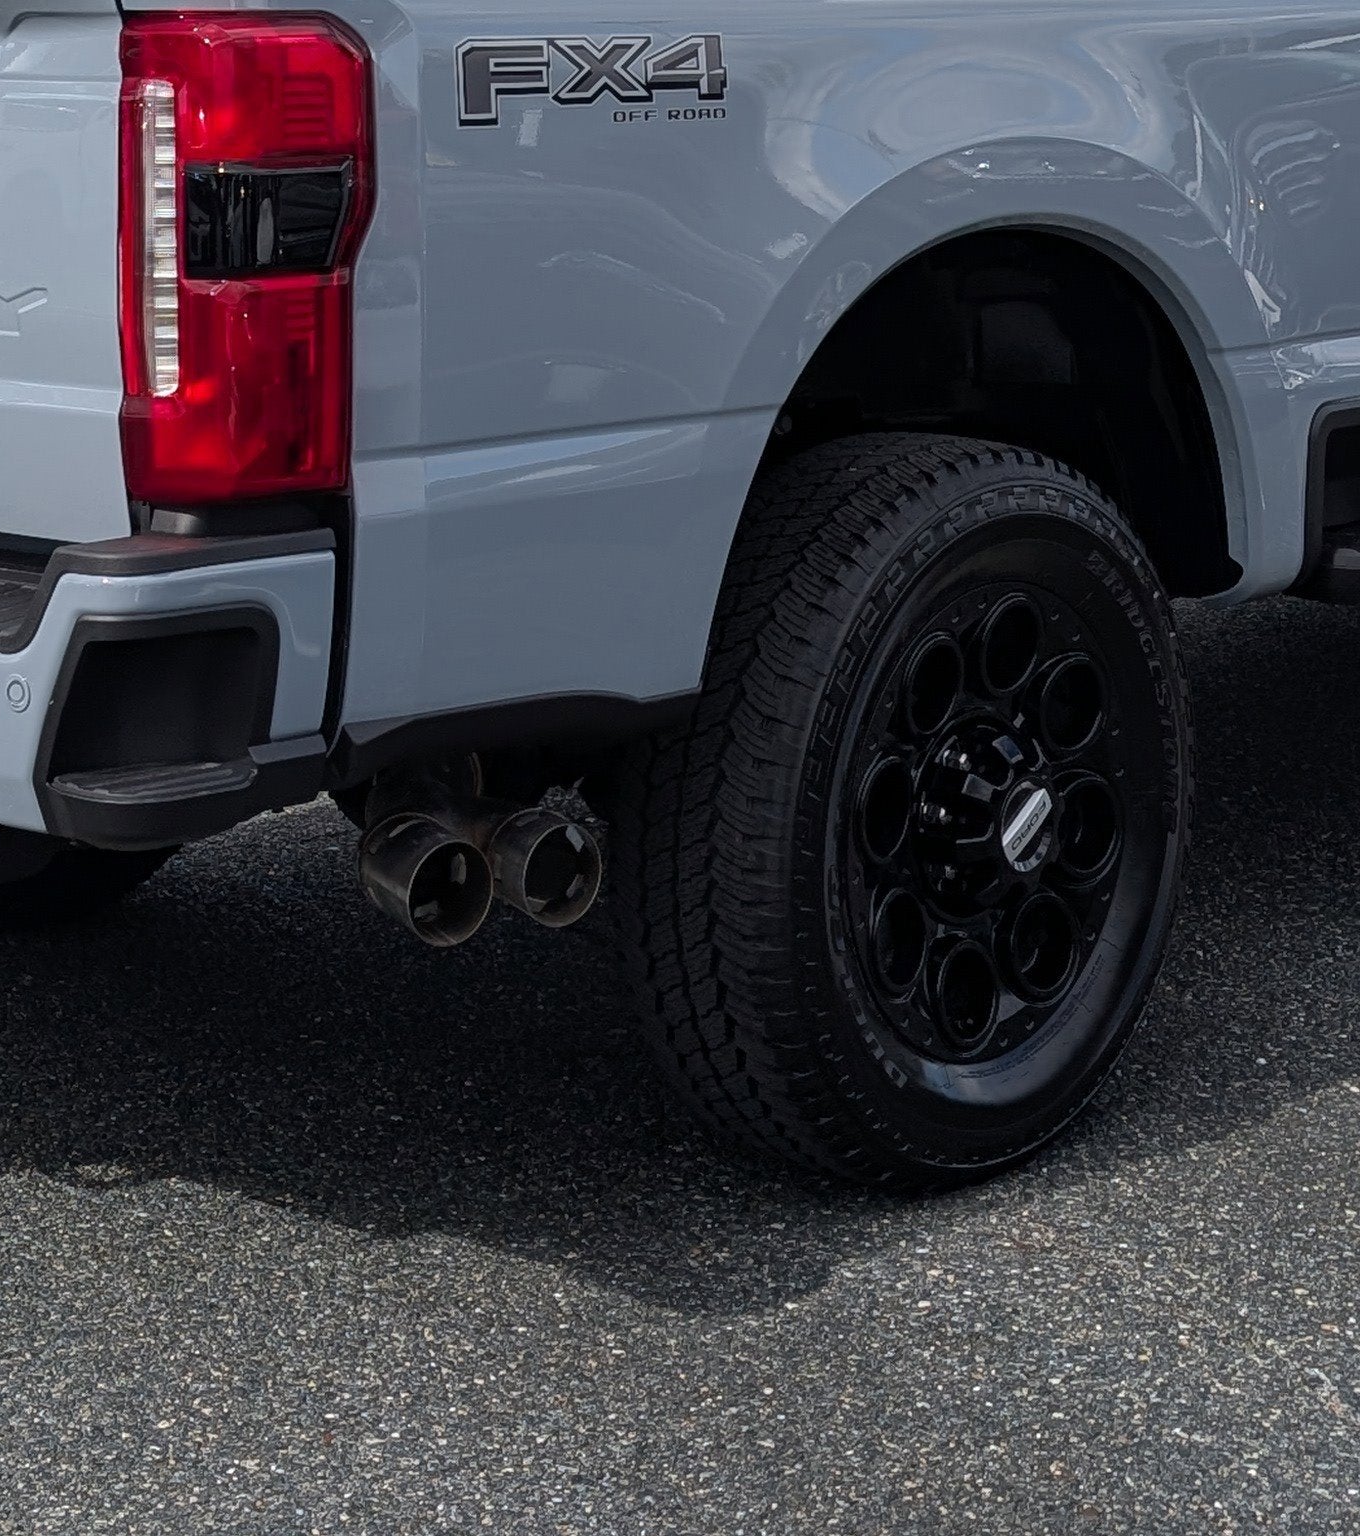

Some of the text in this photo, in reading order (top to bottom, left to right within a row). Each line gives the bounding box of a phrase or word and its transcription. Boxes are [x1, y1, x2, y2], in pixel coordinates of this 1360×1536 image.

[454, 33, 729, 129] FX4
[612, 107, 726, 123] OFF ROAD
[1011, 800, 1047, 851] FORD
